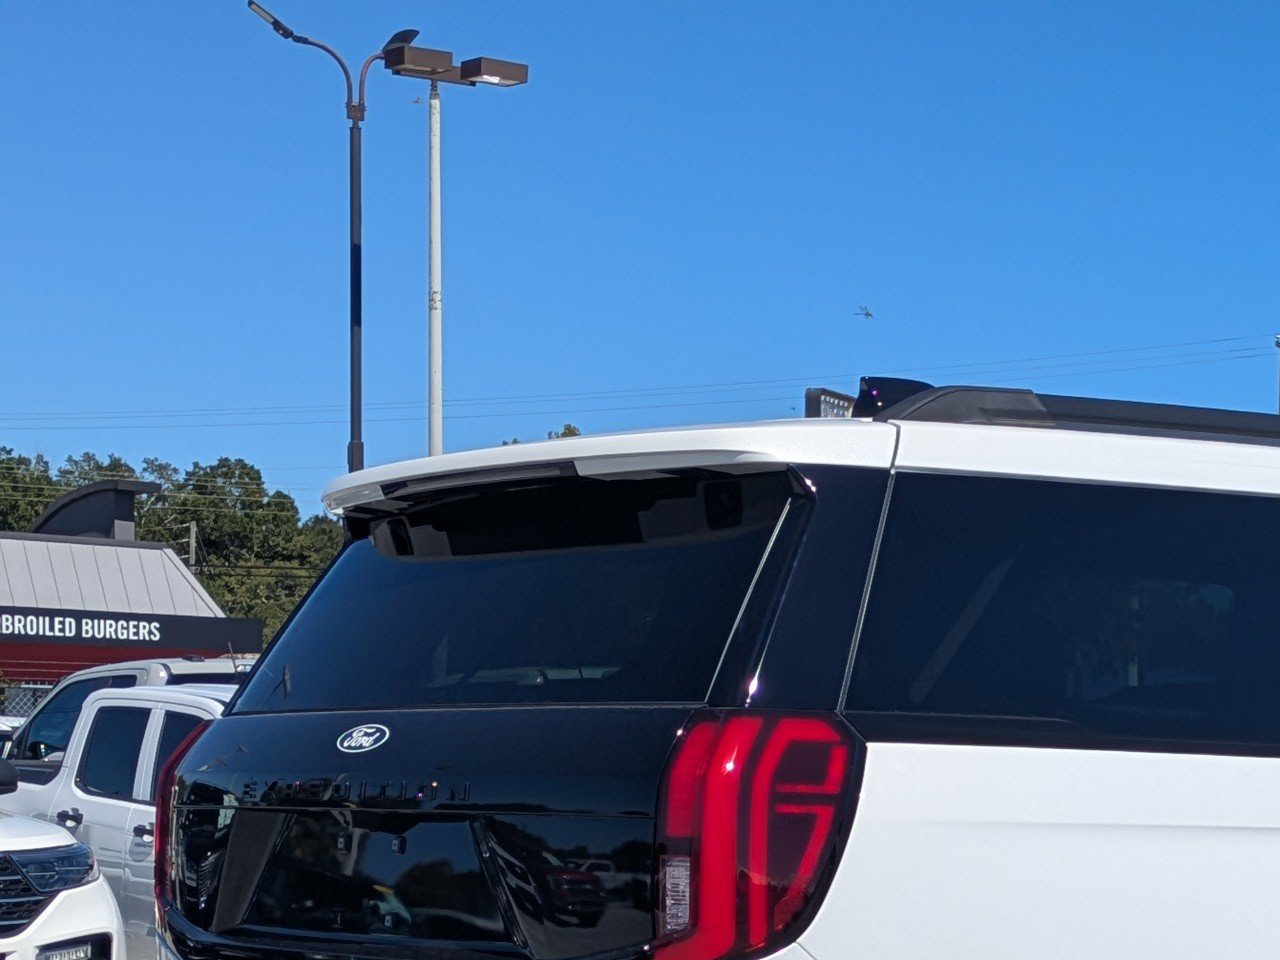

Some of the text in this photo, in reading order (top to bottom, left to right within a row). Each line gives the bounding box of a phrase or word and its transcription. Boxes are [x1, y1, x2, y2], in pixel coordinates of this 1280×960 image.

[0, 614, 161, 641] BROILED BURGERS
[341, 727, 382, 749] Ford
